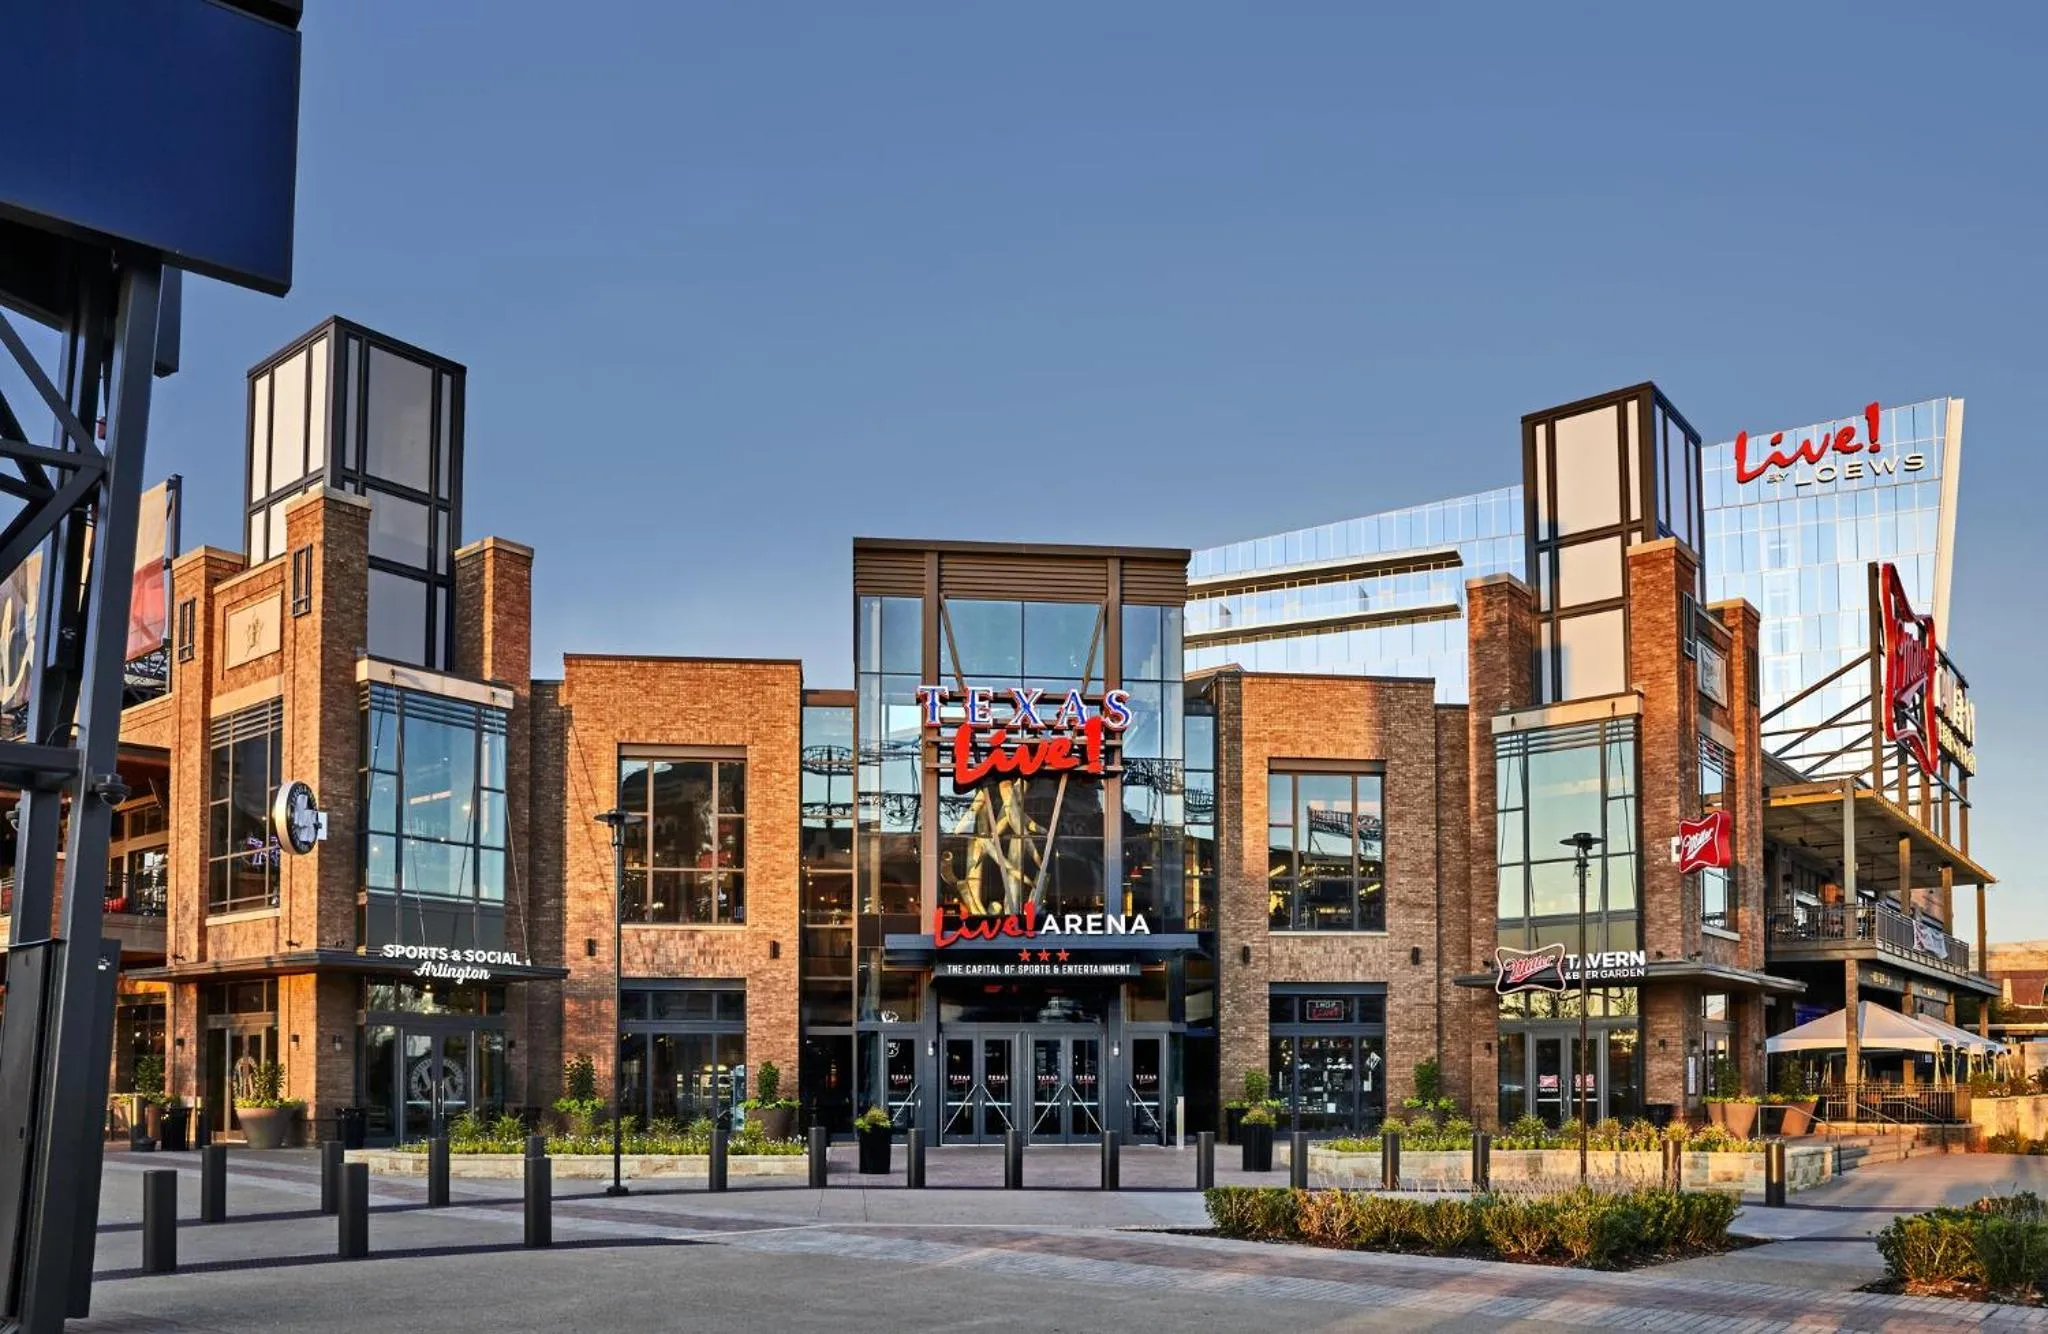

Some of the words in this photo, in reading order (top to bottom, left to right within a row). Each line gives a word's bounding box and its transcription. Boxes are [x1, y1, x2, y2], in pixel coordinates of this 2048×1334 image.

[1735, 401, 1881, 484] Live!
[1795, 452, 1926, 487] LOEWS
[916, 685, 1133, 730] TEXAS
[954, 716, 1104, 786] Live!
[933, 901, 1036, 948] Live!
[1040, 914, 1151, 935] ARENA
[383, 944, 448, 960] SPORTS
[450, 949, 461, 961] &
[464, 950, 521, 966] SOCIAL
[947, 964, 963, 975] THE
[966, 964, 1001, 975] CAPITAL
[1004, 964, 1015, 975] OF
[1018, 964, 1051, 975] SPORTS
[1053, 964, 1059, 975] &
[1062, 964, 1131, 975] ENTERTAINMENT
[414, 961, 491, 985] Arlington
[1600, 968, 1645, 979] GARDEN
